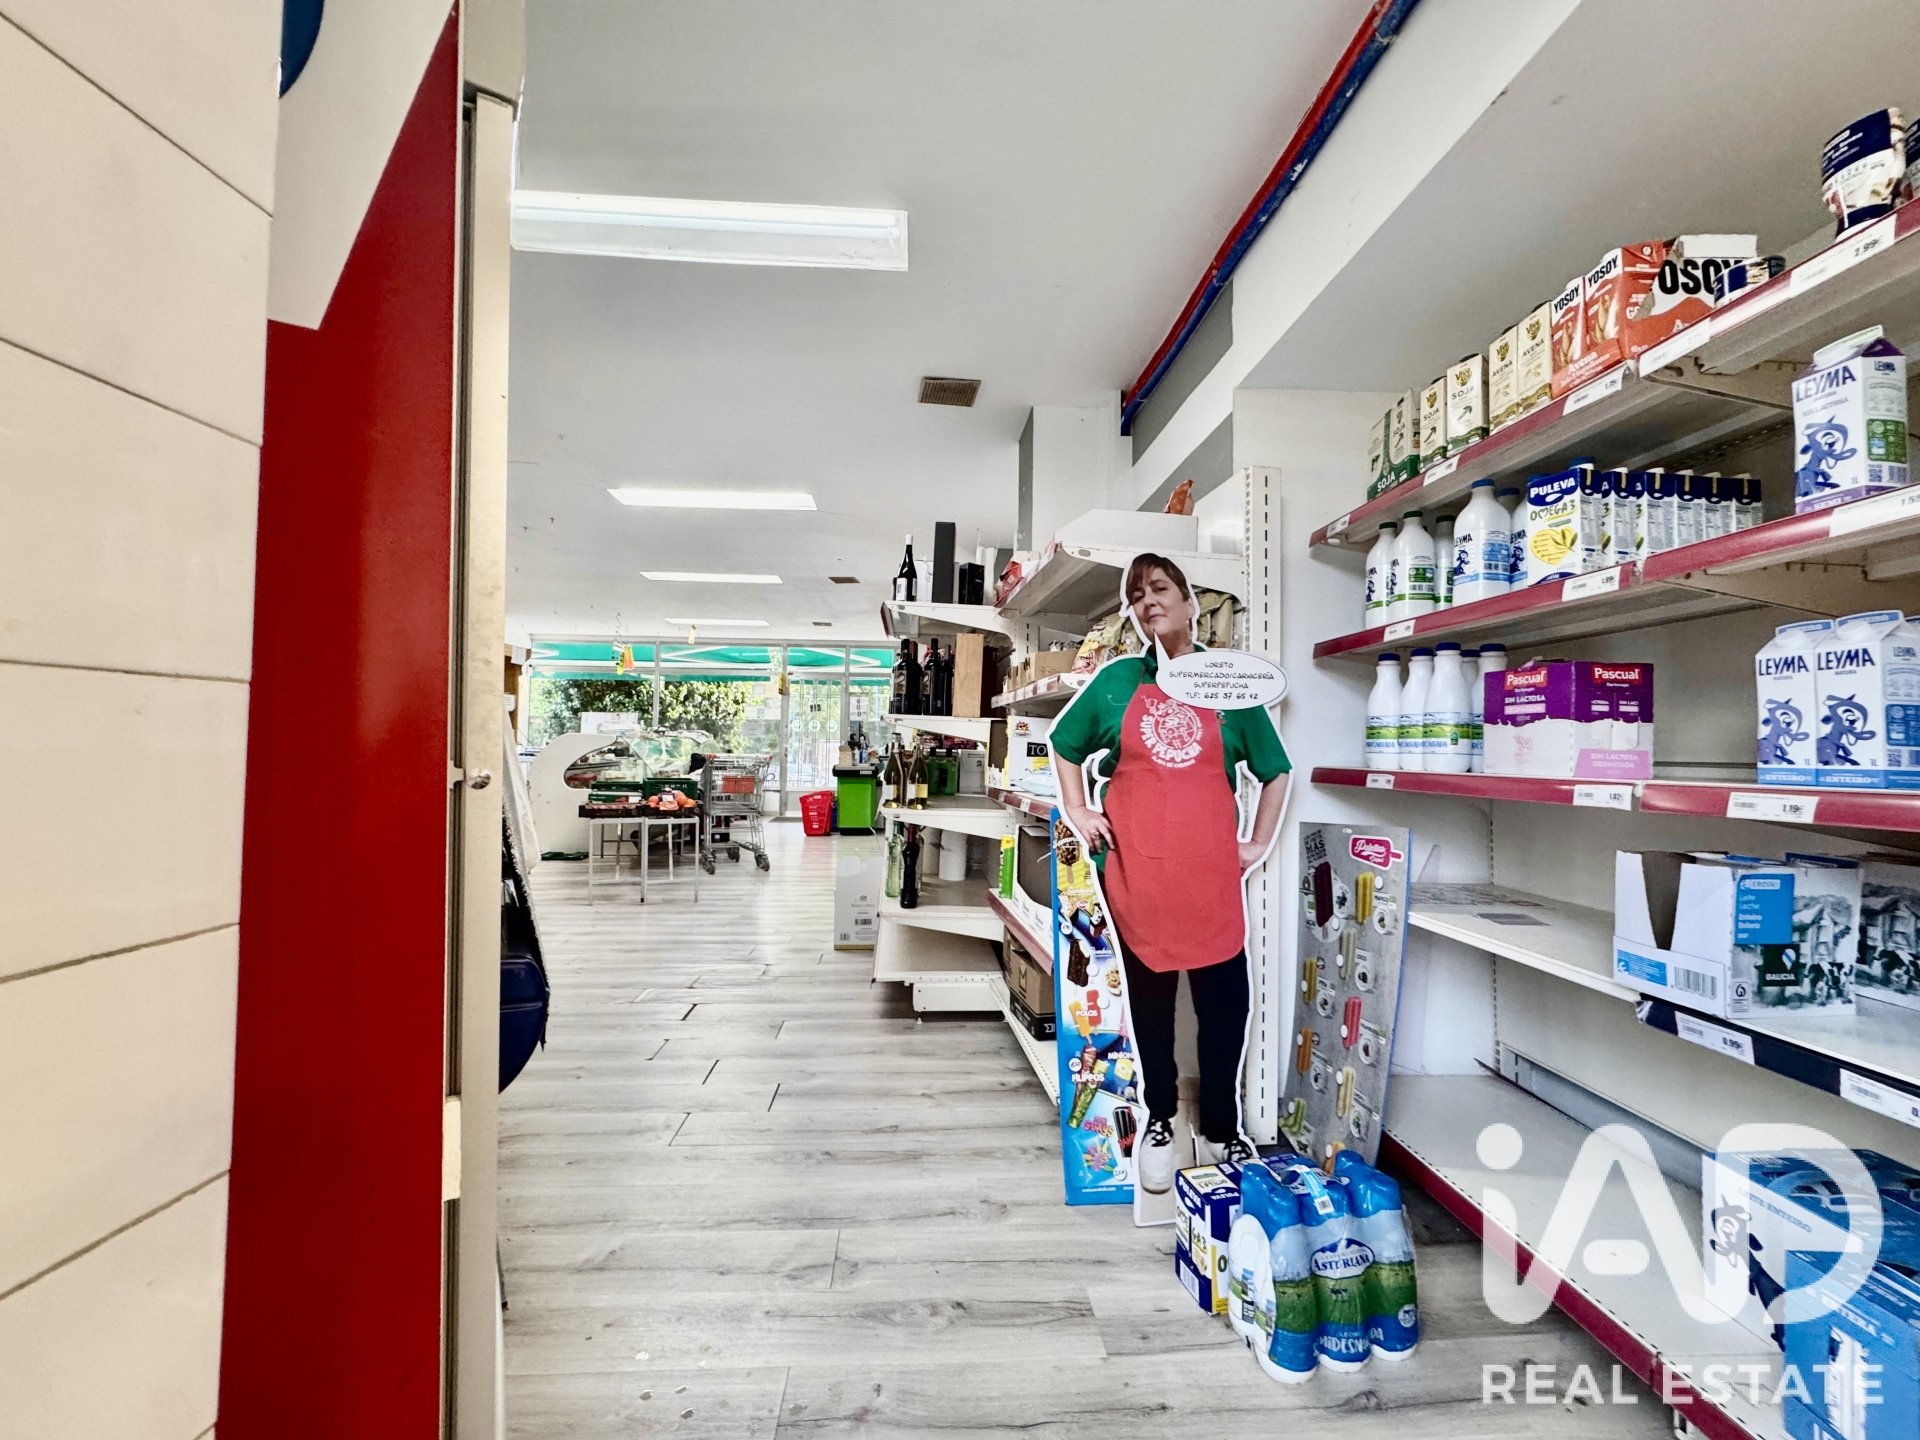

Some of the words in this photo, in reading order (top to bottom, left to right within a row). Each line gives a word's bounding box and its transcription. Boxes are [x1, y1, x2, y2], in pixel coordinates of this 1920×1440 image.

[1587, 254, 1619, 288] YOSOY
[1553, 284, 1580, 314] YOSOY
[1521, 338, 1545, 358] AVENA
[1491, 359, 1513, 378] AVENA
[1451, 385, 1474, 400] SOJA
[1796, 365, 1856, 403] LEYMA
[1423, 407, 1440, 421] SOJA
[1377, 472, 1396, 492] SOJA
[1529, 477, 1576, 499] PULEVA
[1530, 503, 1568, 521] OMEGA
[1570, 499, 1576, 510] 3
[1454, 533, 1473, 548] LEYMA
[1510, 529, 1527, 544] EYMA
[1759, 655, 1810, 676] LEYMA
[1817, 648, 1876, 671] LEYMA
[1507, 670, 1546, 686] Pascual
[1594, 668, 1640, 680] Pascual
[1223, 692, 1232, 700] 37
[1516, 694, 1546, 703] LACTOSA
[1139, 714, 1158, 749] SUPER
[1075, 1009, 1098, 1017] POLOS
[1107, 1051, 1133, 1060] MINION
[1210, 1192, 1240, 1200] PULEVA
